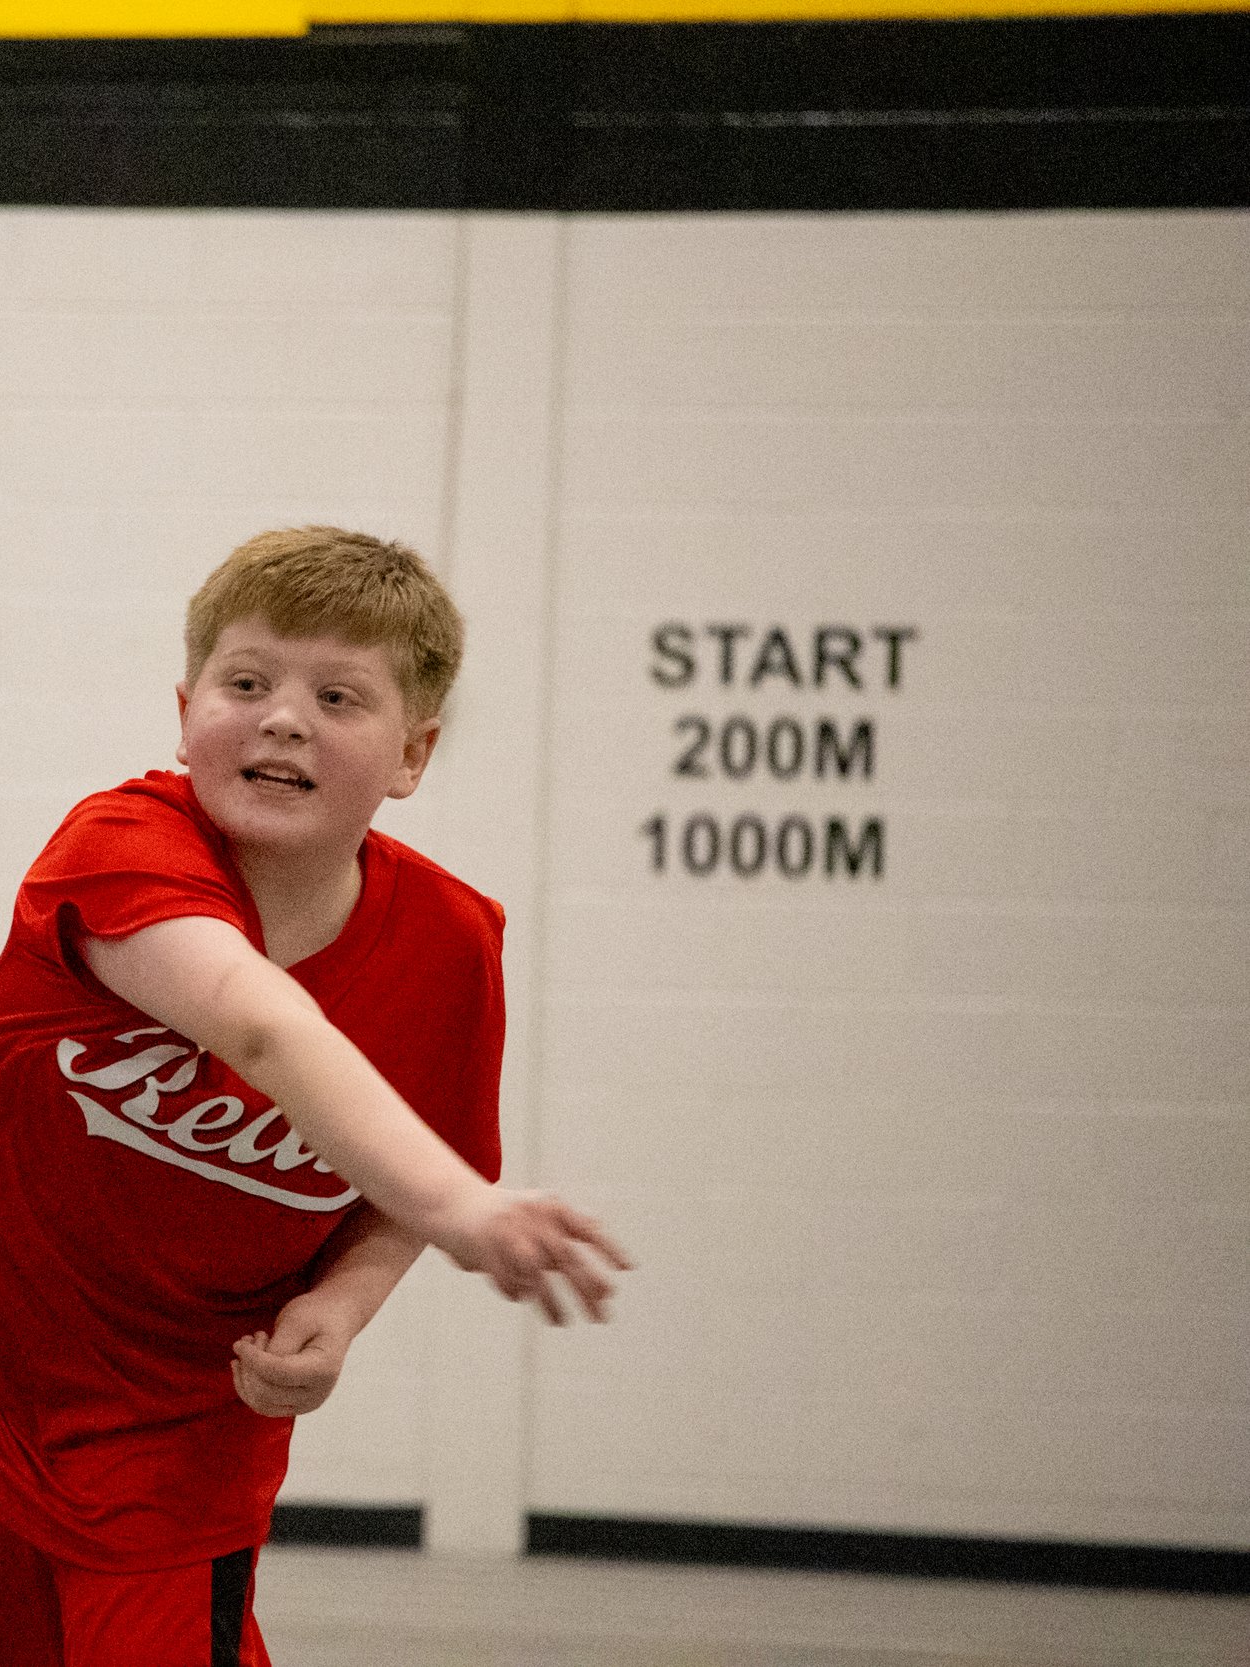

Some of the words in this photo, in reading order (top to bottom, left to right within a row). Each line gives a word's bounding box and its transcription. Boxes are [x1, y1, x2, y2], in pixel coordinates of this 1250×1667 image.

[650, 622, 919, 690] START
[672, 715, 878, 780] 200M
[642, 814, 886, 880] 1000M
